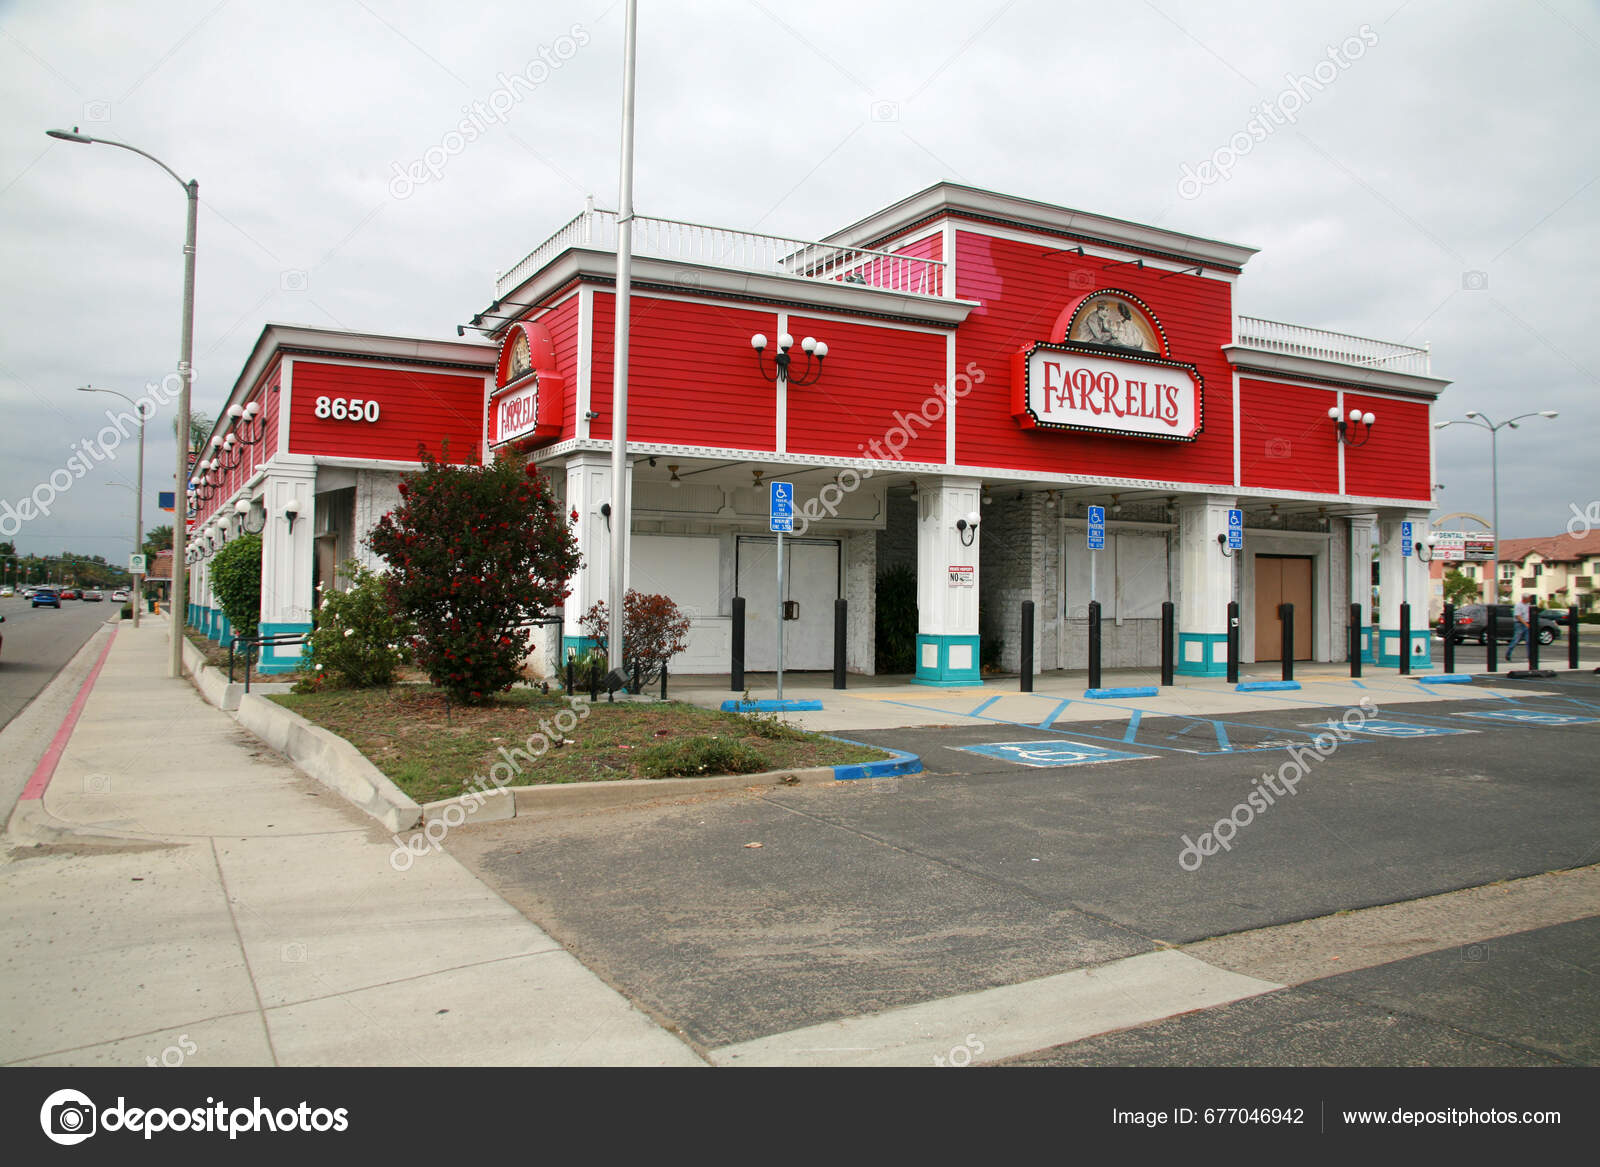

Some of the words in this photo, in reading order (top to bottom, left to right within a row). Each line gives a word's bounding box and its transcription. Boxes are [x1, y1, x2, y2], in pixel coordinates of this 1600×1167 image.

[1042, 361, 1180, 427] FARRELL'S
[314, 395, 380, 423] 8650
[950, 572, 959, 582] NO
